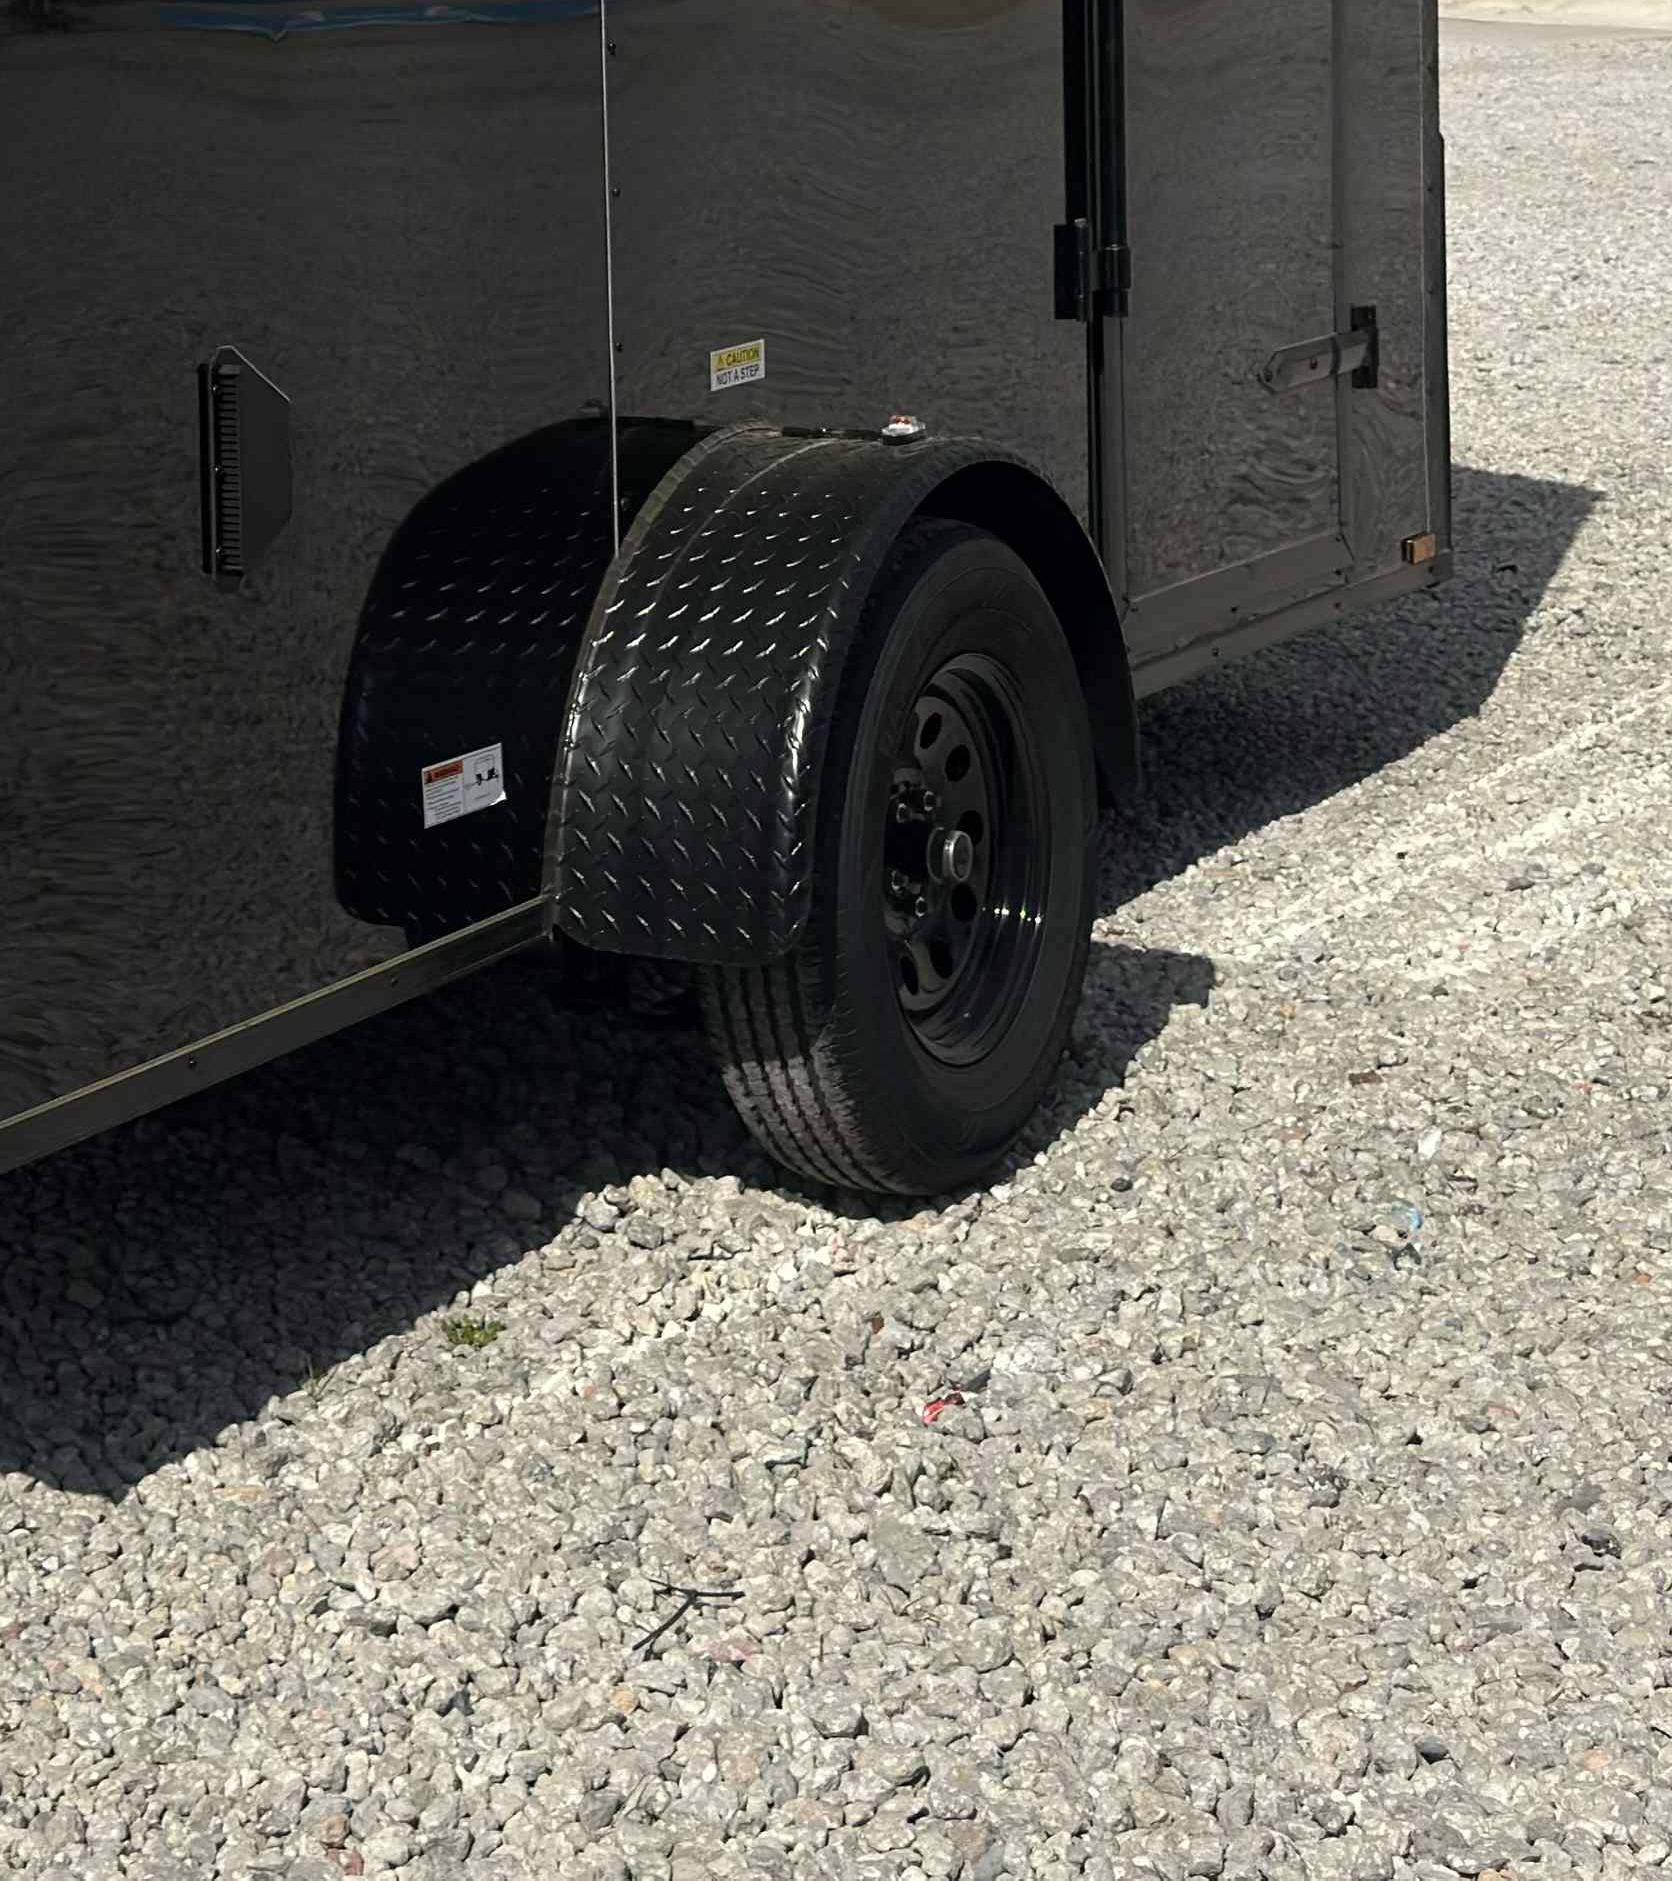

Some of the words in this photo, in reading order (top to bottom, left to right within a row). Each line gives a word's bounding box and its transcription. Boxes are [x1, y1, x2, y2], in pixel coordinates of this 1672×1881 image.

[726, 348, 760, 366] CAUTION
[716, 371, 732, 385] NOT
[733, 369, 740, 382] A
[741, 365, 760, 380] STEP
